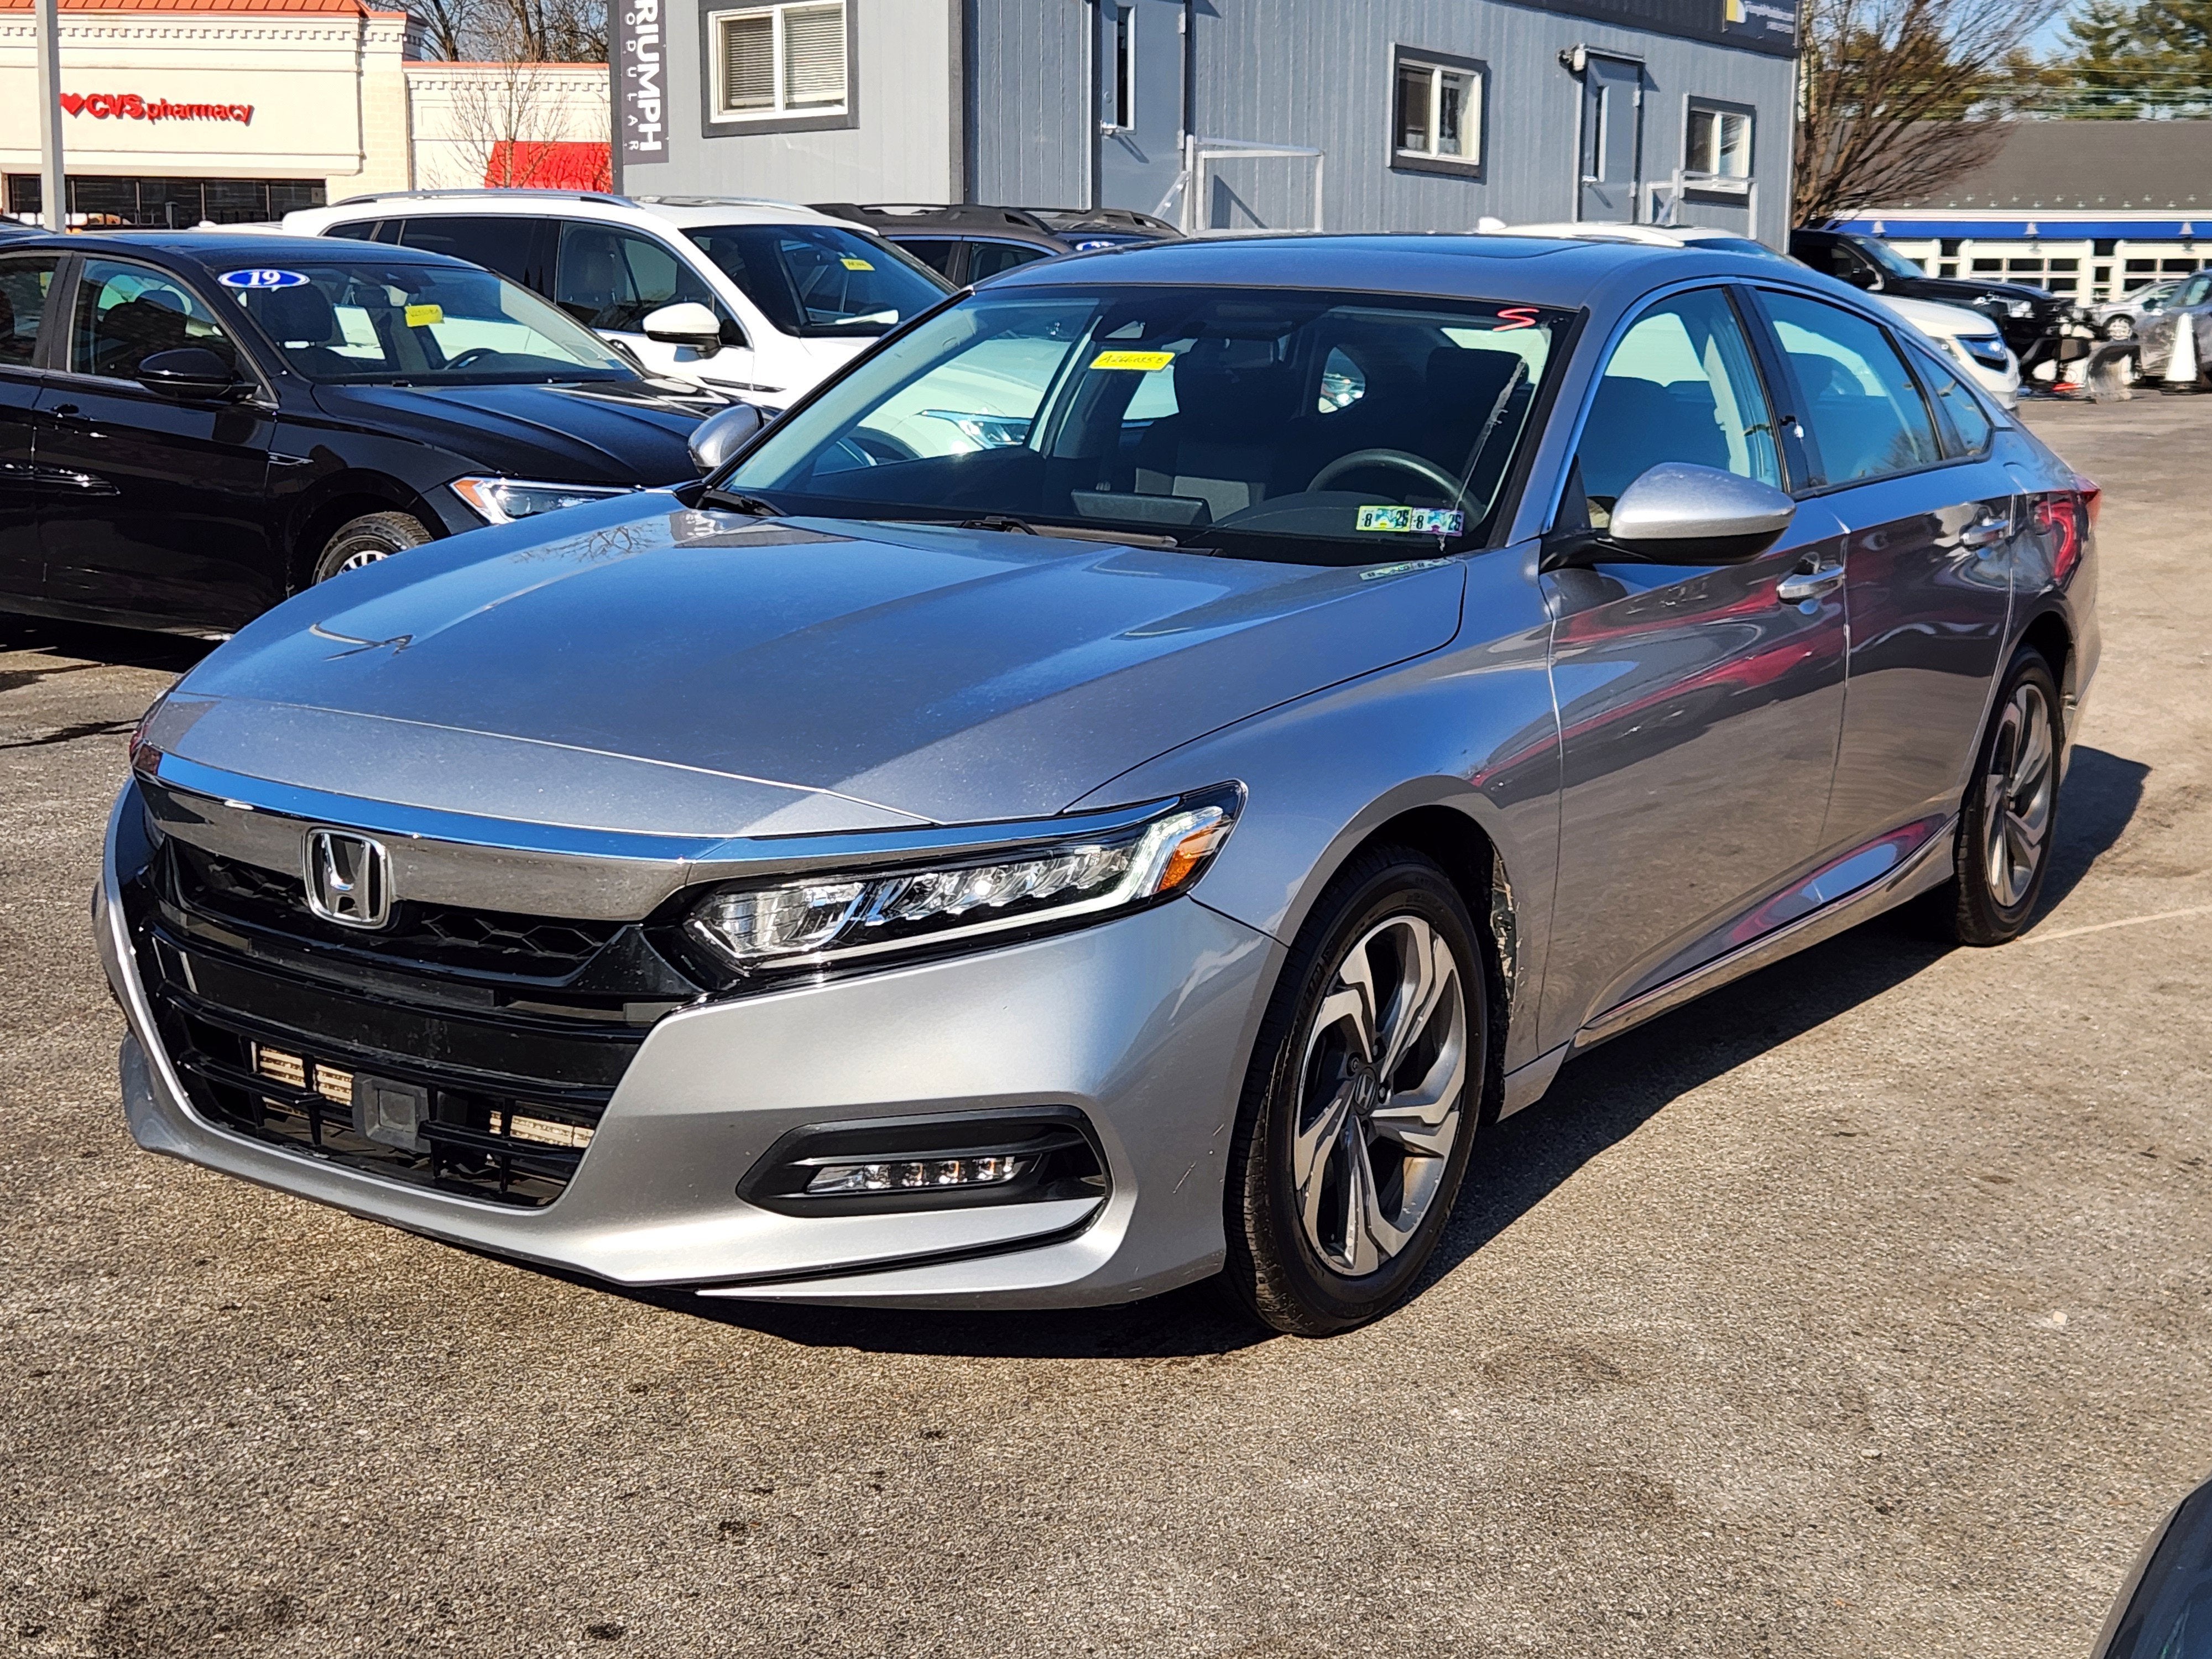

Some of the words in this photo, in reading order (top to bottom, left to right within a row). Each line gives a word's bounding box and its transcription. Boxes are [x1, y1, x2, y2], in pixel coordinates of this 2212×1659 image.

[85, 93, 145, 119] CVS
[147, 97, 253, 125] pharmacy
[248, 270, 281, 286] 19
[1364, 513, 1373, 528] 8
[1416, 515, 1425, 530] 8
